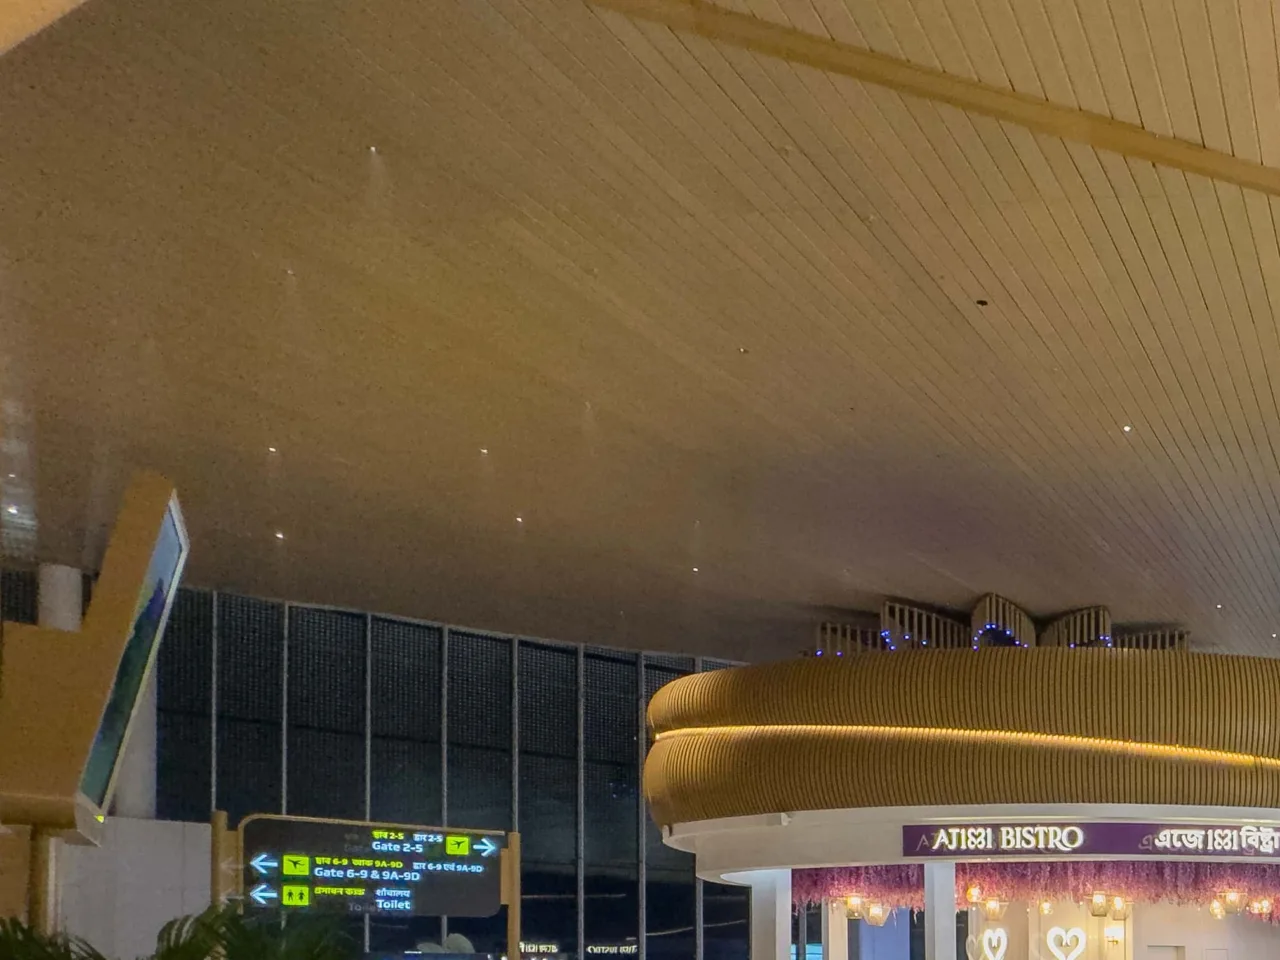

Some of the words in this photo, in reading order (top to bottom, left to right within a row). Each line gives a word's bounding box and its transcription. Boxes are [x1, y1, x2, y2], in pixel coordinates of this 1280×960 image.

[389, 832, 404, 840] 2-5
[428, 834, 443, 843] 2-5
[1000, 826, 1085, 851] BISTRO
[372, 841, 400, 852] Gate
[402, 843, 423, 853] 2-5
[332, 858, 348, 866] 6-9
[374, 860, 404, 869] 9A-9D
[427, 862, 442, 871] 6-9
[456, 864, 484, 873] 9A-9D
[314, 867, 344, 878] Gate
[346, 869, 368, 879] 6-9
[370, 870, 380, 879] &
[382, 871, 420, 881] 9A-9D
[375, 899, 411, 910] Toilet
